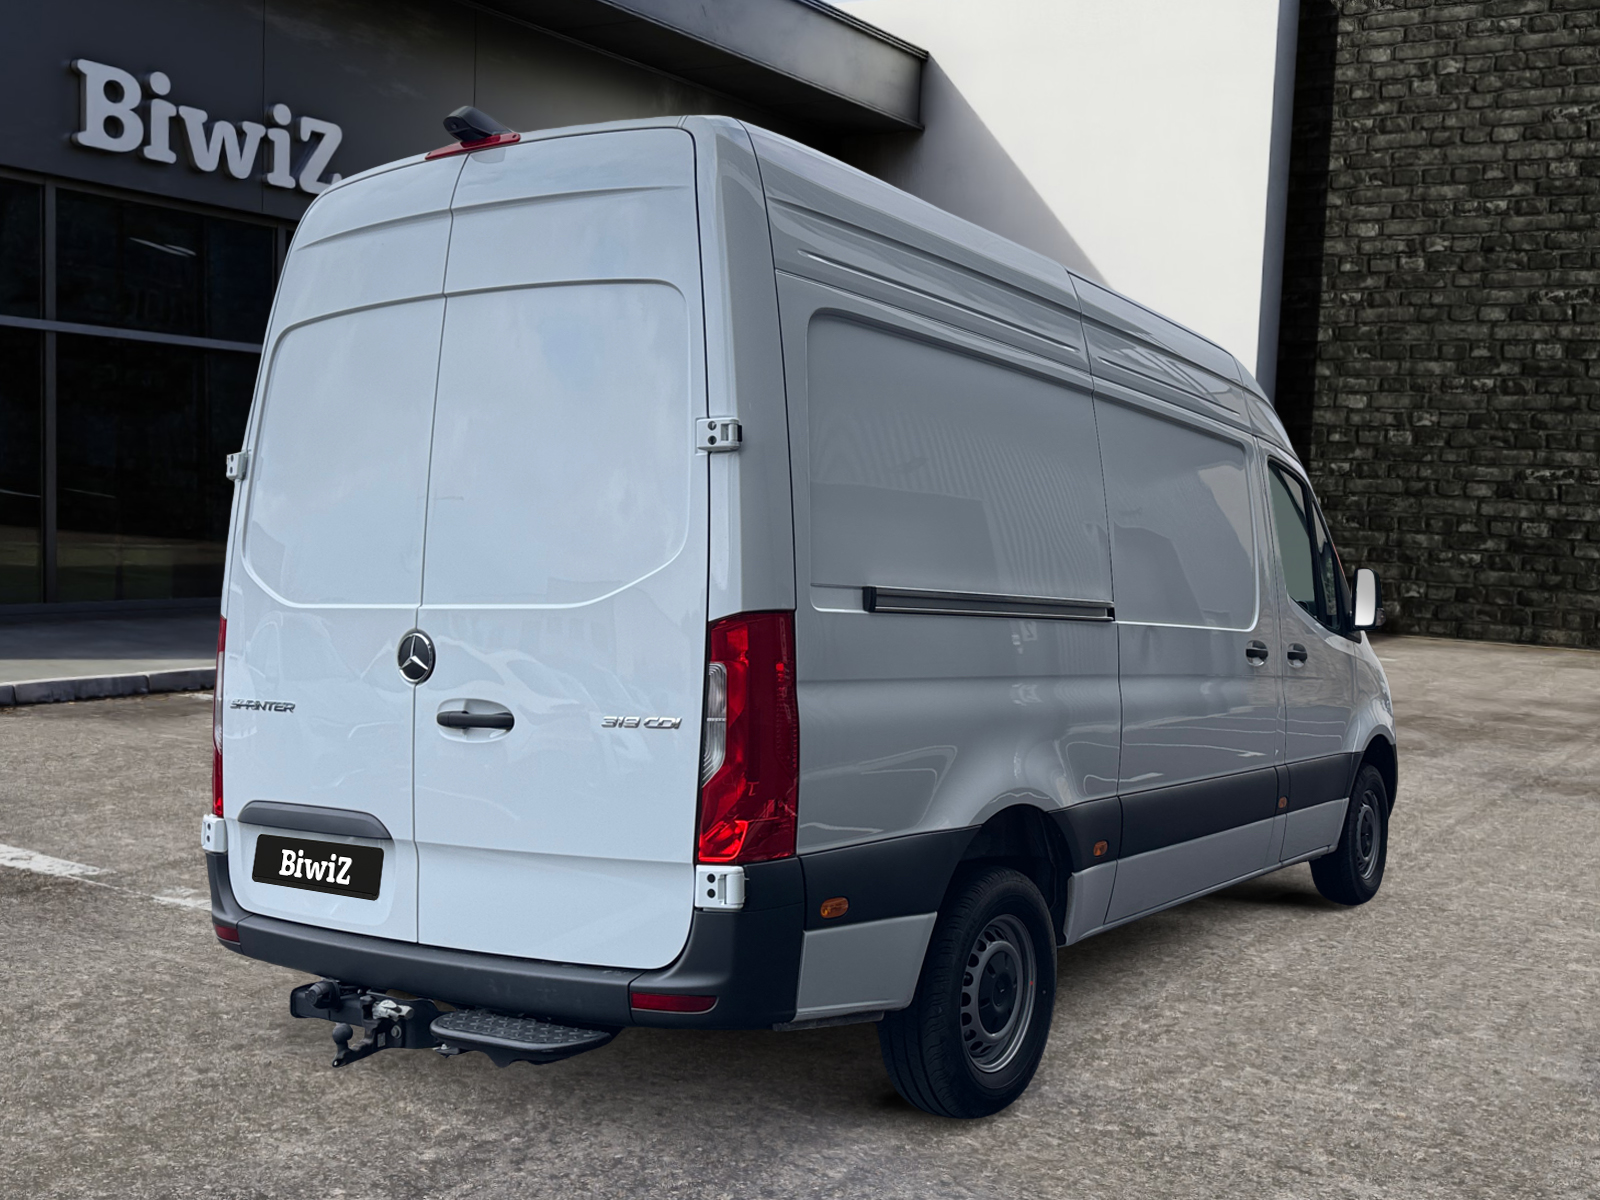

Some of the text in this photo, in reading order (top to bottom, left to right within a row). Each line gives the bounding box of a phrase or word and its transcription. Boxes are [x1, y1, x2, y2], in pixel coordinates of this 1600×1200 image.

[73, 59, 343, 195] BiwiZ
[601, 715, 682, 729] 319 CDI
[279, 849, 352, 885] BiwiZ
